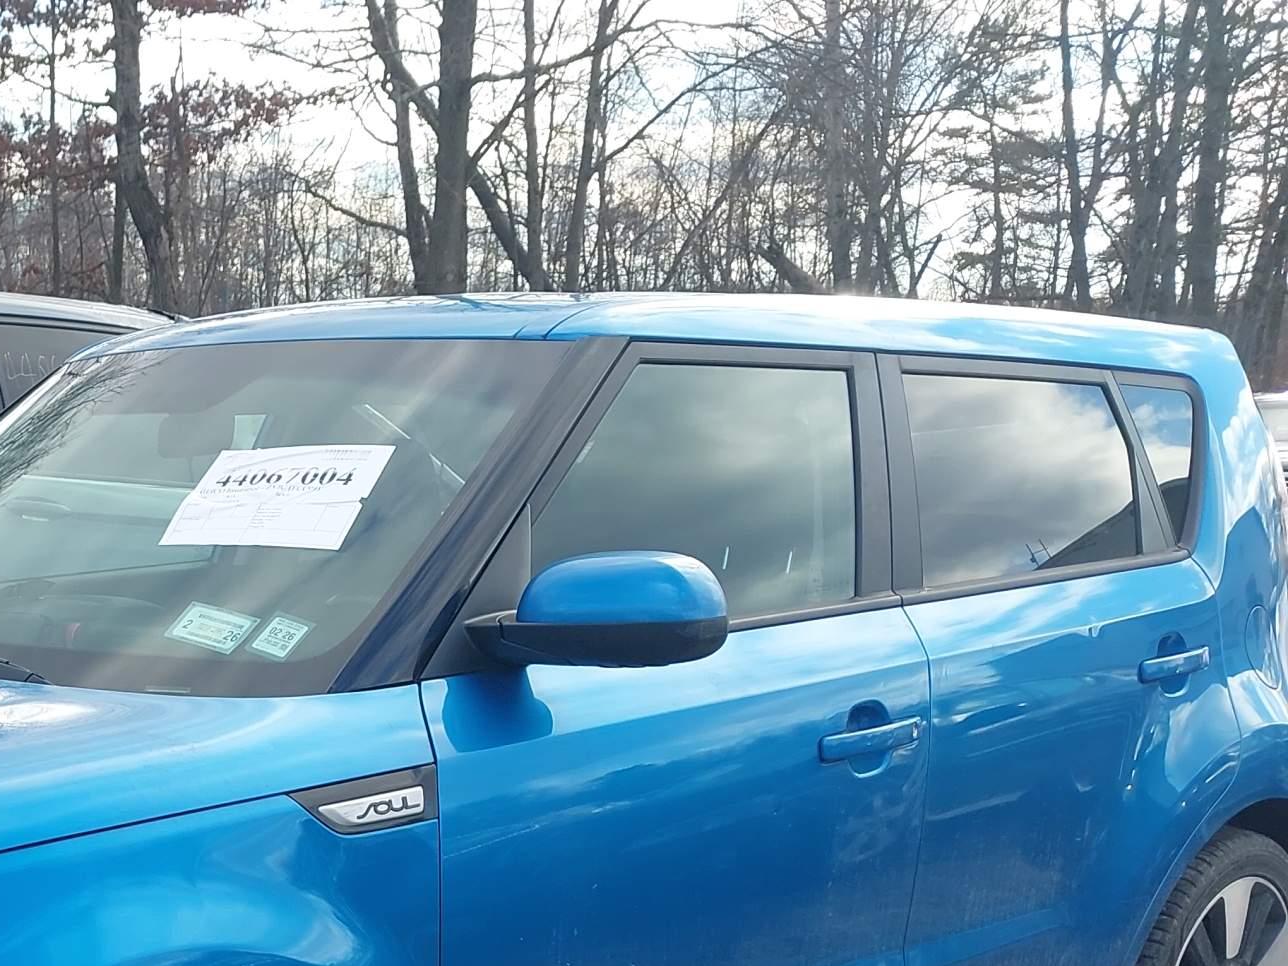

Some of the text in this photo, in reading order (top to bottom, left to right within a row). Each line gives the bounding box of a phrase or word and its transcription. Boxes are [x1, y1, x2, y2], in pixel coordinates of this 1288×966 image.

[215, 467, 354, 487] 44067004
[222, 630, 242, 642] 26
[356, 796, 421, 819] SOUL
